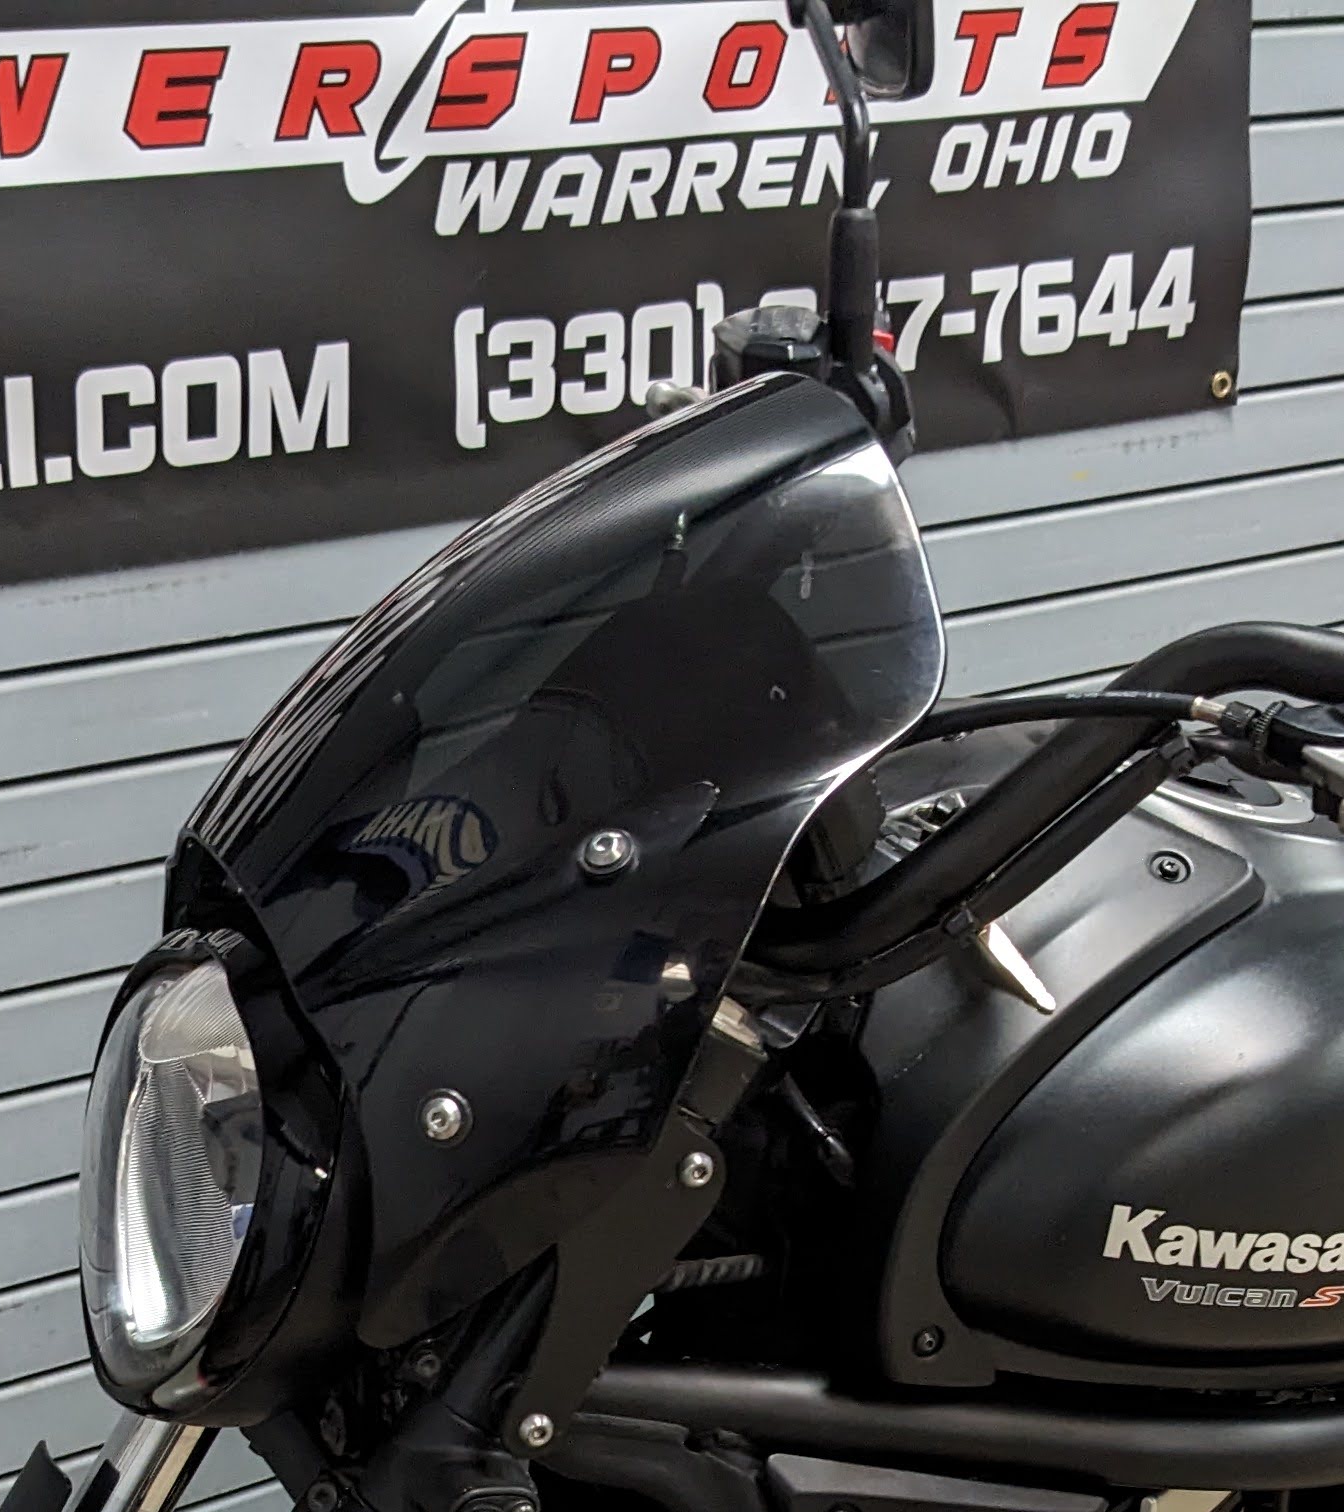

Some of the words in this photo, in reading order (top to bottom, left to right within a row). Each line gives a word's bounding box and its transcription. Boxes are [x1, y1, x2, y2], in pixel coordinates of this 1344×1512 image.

[929, 110, 1135, 193] OHIO
[757, 246, 1197, 373] 7-7644
[1140, 1276, 1298, 1309] Vulcan
